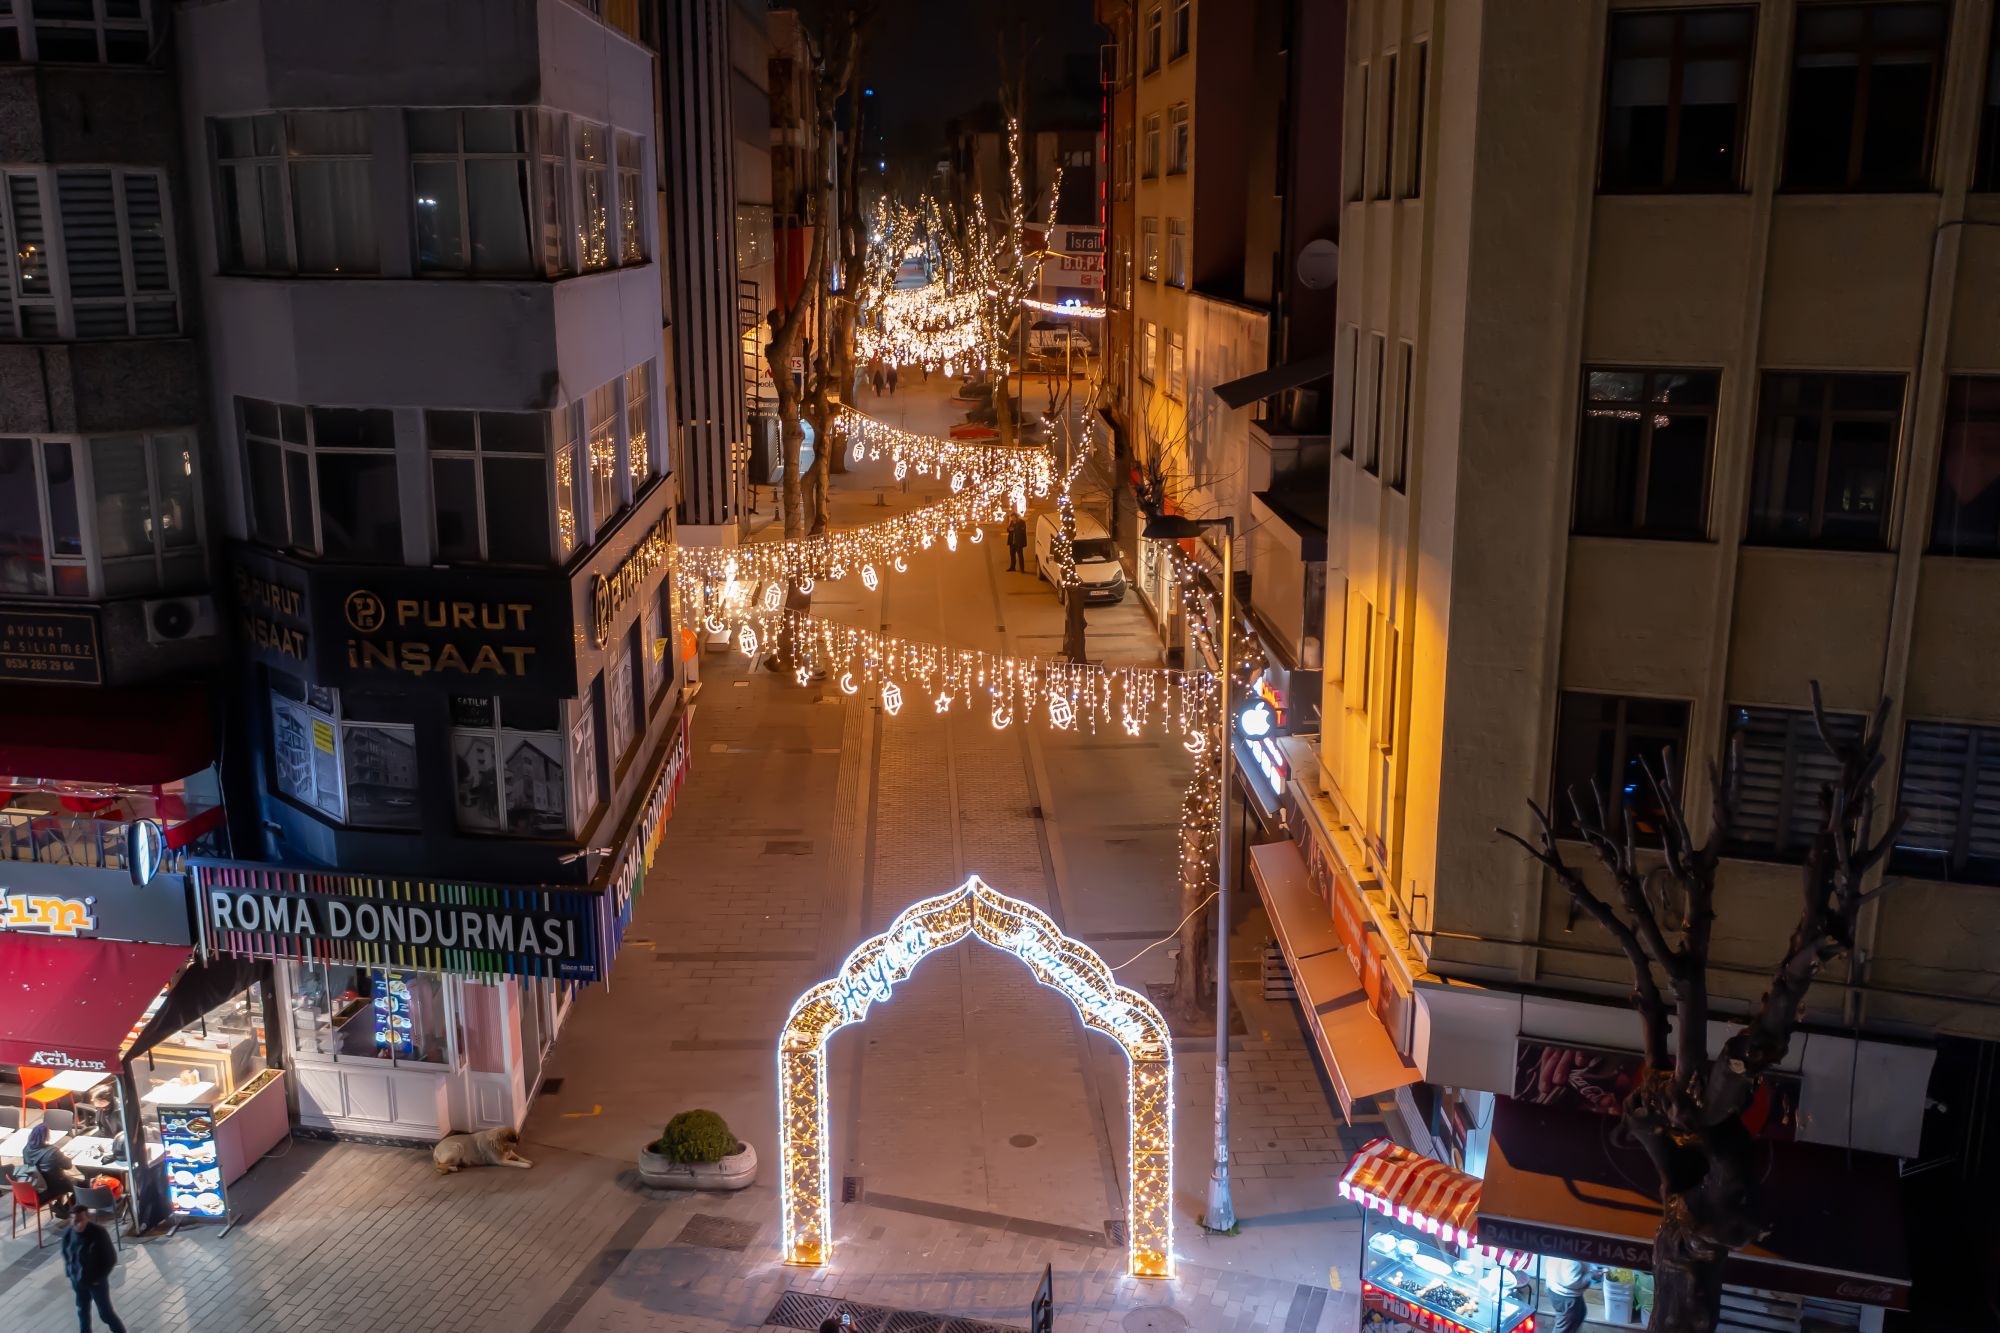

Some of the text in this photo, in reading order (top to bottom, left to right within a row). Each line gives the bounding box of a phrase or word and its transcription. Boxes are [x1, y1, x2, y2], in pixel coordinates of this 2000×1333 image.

[7, 623, 65, 640] AVUKAT
[397, 599, 533, 632] PURUT
[616, 735, 685, 917] ROMA DONDURMASI
[211, 890, 576, 958] ROMA DONDURMASI
[1484, 1224, 1654, 1266] BALIKÇIMIZ HASA
